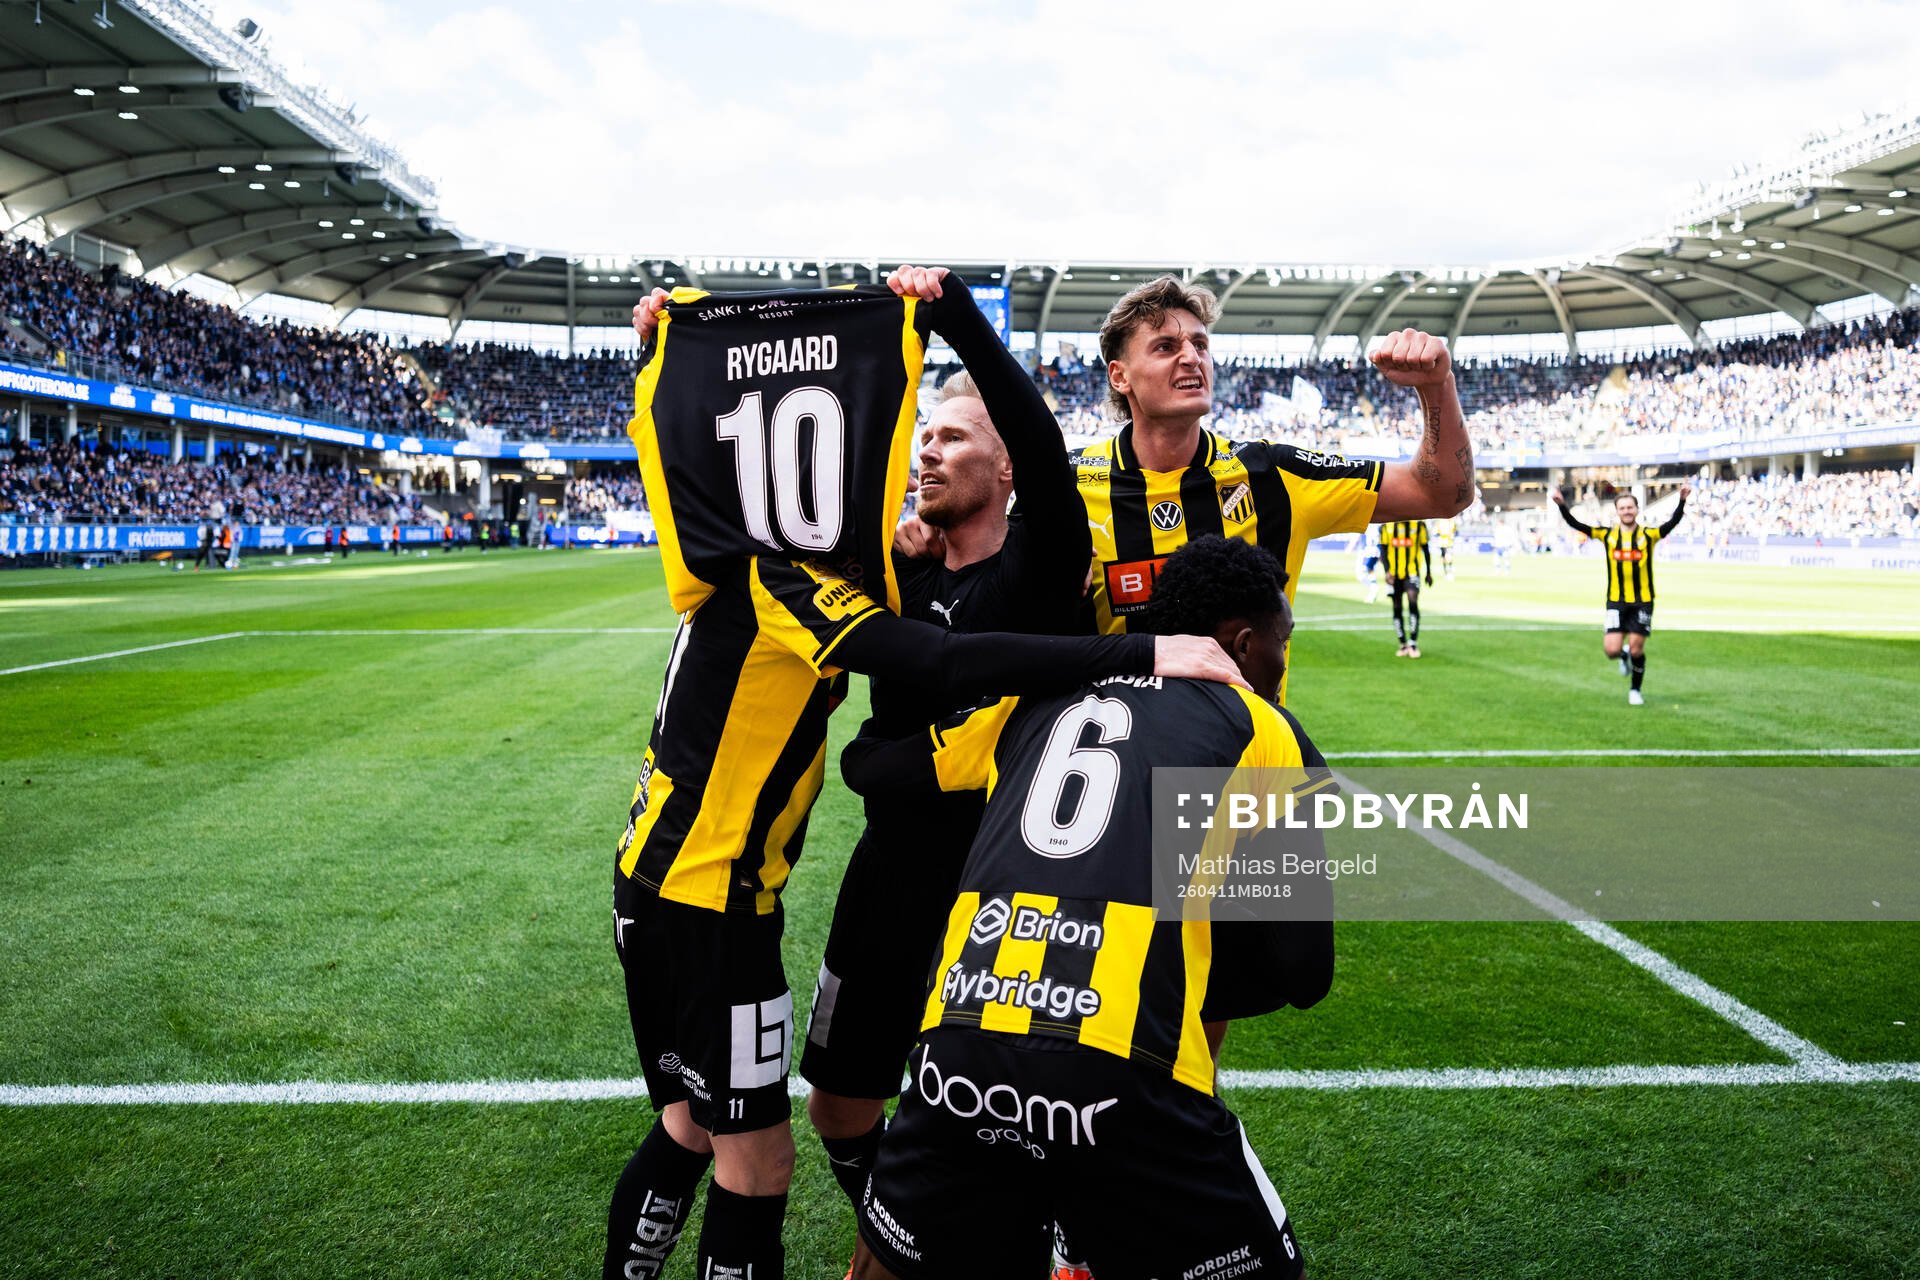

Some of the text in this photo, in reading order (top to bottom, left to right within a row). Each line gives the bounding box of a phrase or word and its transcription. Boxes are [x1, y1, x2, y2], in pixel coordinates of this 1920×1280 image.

[758, 309, 794, 320] RESORT
[726, 335, 838, 381] RYGAARD
[715, 386, 845, 552] 10
[1077, 471, 1109, 484] EXE
[1120, 573, 1143, 593] B
[1021, 694, 1132, 859] 6
[1049, 837, 1069, 846] 1940
[1013, 908, 1103, 949] Brion
[941, 961, 1101, 1019] Hybridge
[680, 1064, 706, 1089] ORDIK
[728, 1097, 745, 1120] 11
[976, 1127, 1046, 1160] group
[866, 1206, 922, 1262] GRUNDTEKNIK
[873, 1196, 915, 1247] NORDISK
[1182, 1245, 1252, 1280] NORDISK
[1282, 1232, 1296, 1260] 6
[1201, 1256, 1263, 1280] DTEKNIK
